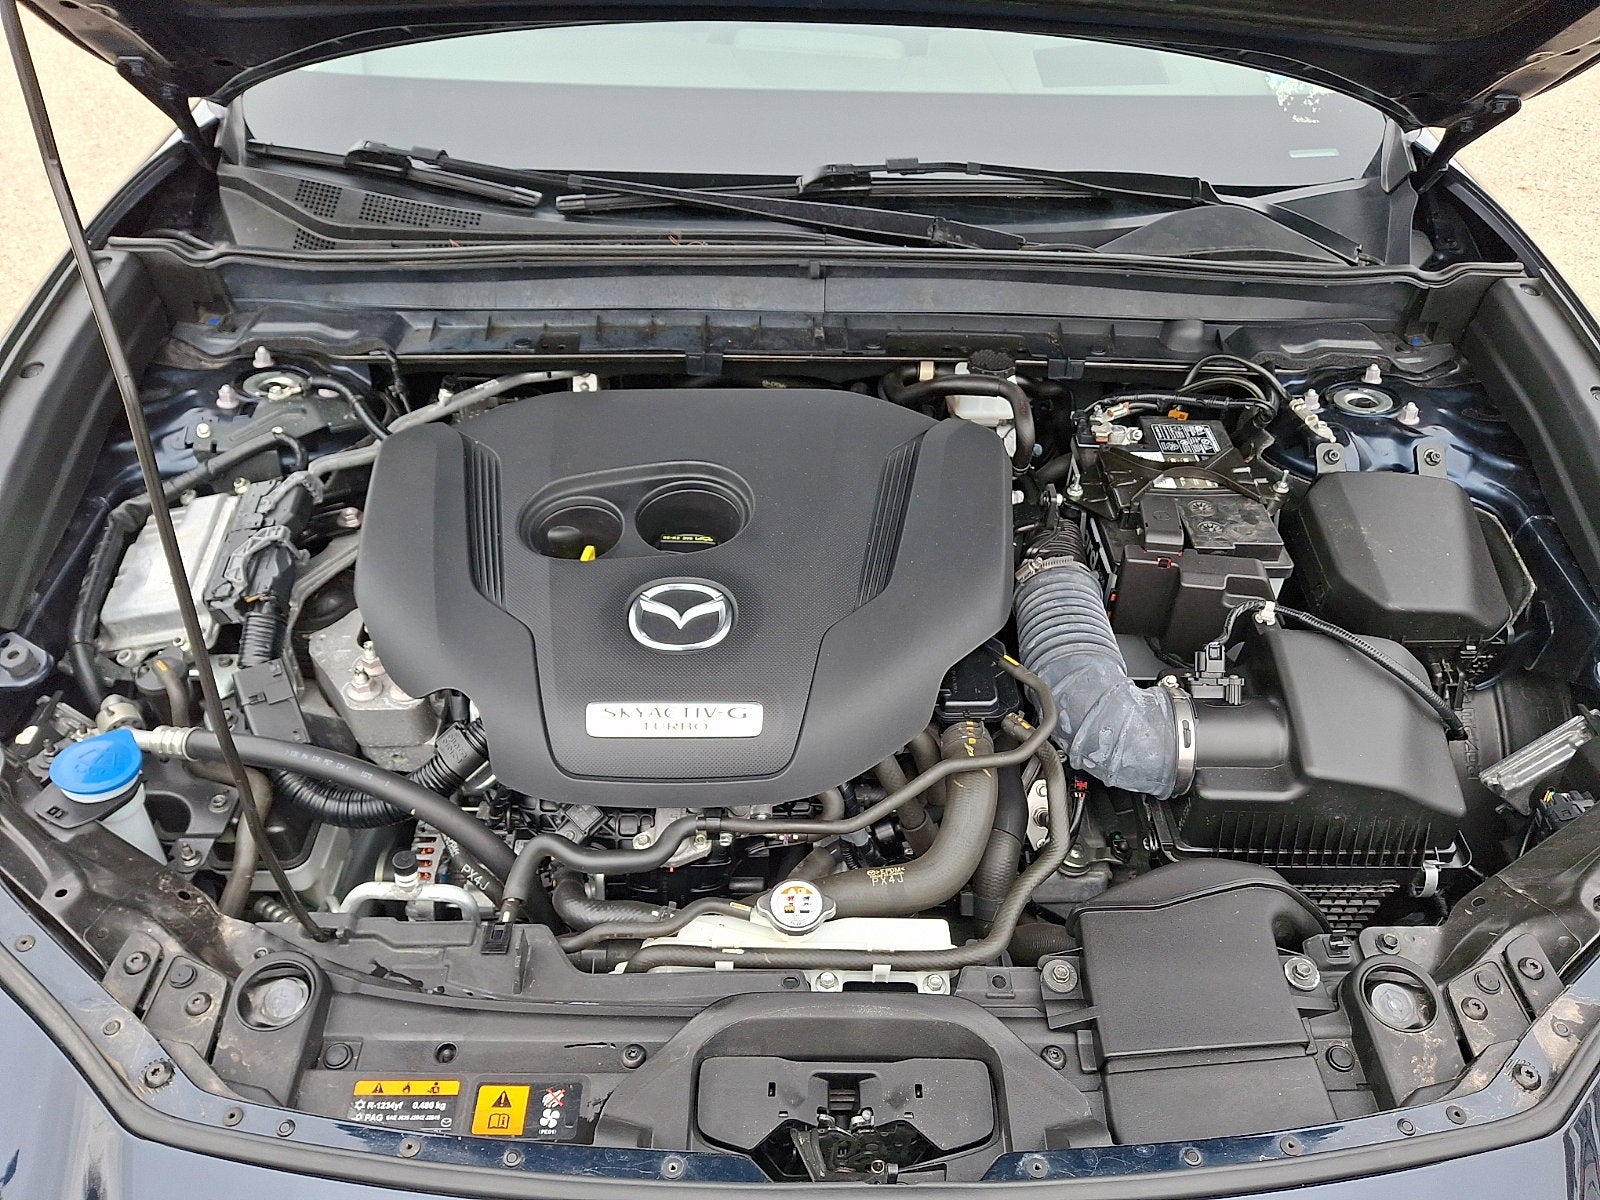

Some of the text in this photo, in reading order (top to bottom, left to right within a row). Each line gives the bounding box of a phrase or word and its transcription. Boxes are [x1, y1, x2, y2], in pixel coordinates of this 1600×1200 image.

[604, 707, 747, 719] SKYACTIV-G
[643, 722, 709, 731] TURBO
[460, 863, 490, 890] PX4J
[871, 874, 904, 887] PX4J
[364, 1113, 384, 1121] PAG
